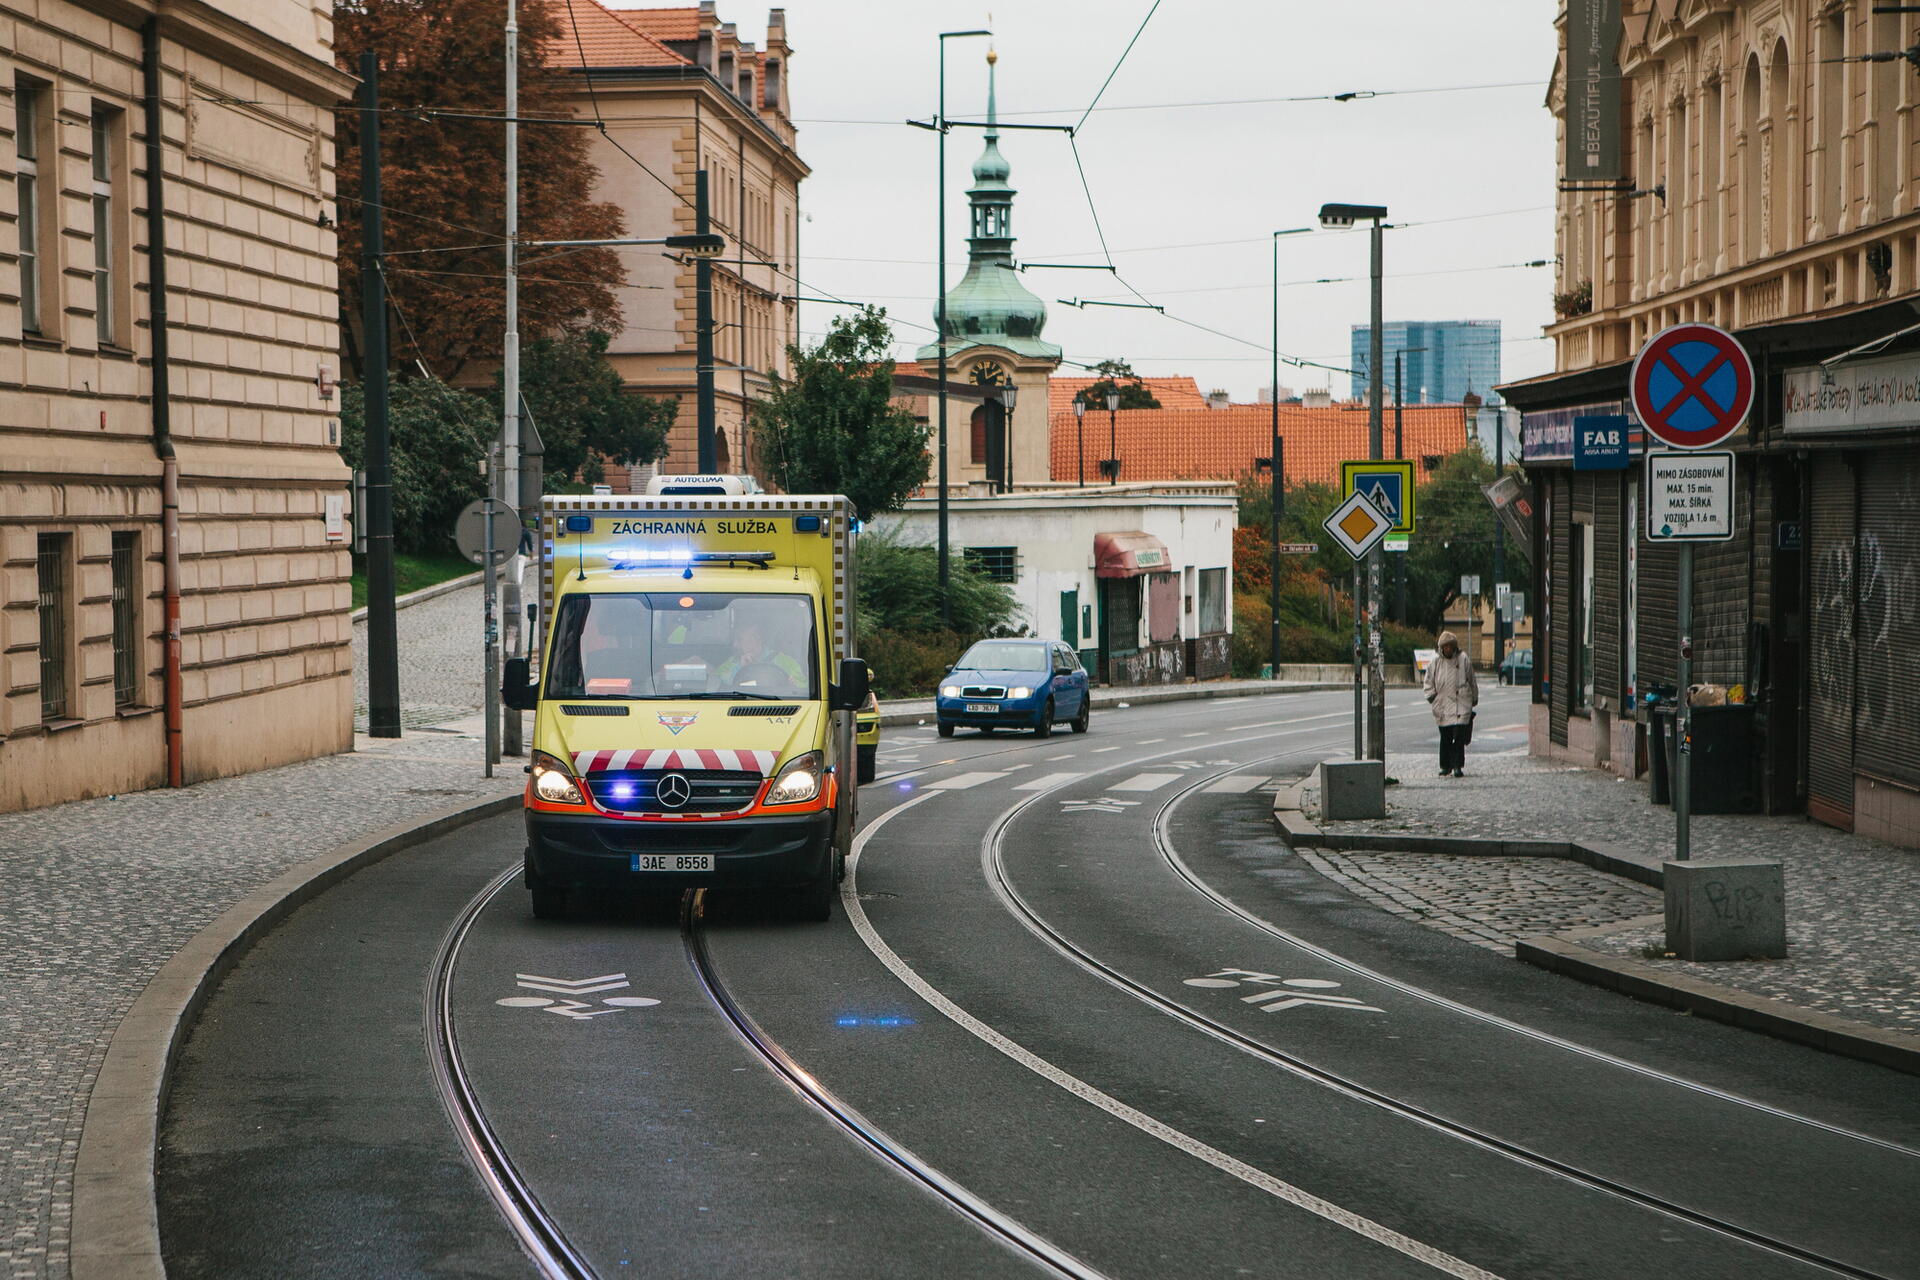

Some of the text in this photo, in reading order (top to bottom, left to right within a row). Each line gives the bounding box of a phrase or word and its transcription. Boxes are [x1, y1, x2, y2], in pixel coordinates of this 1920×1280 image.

[1587, 62, 1600, 152] BEAUTIFUL
[1583, 431, 1620, 447] FAB
[1656, 467, 1725, 479] MIMO ZÁSOBOVÁNÍ
[1667, 484, 1714, 494] MAX. 15 min.
[1669, 496, 1712, 508] MAX. ŠÍŘKA
[1664, 513, 1695, 523] VOZIDLA
[1697, 513, 1708, 523] 1,6
[612, 519, 777, 534] ZÁCHRANNÁ SLUŽBA
[766, 717, 792, 725] 147
[642, 856, 709, 870] 3AE 8558
